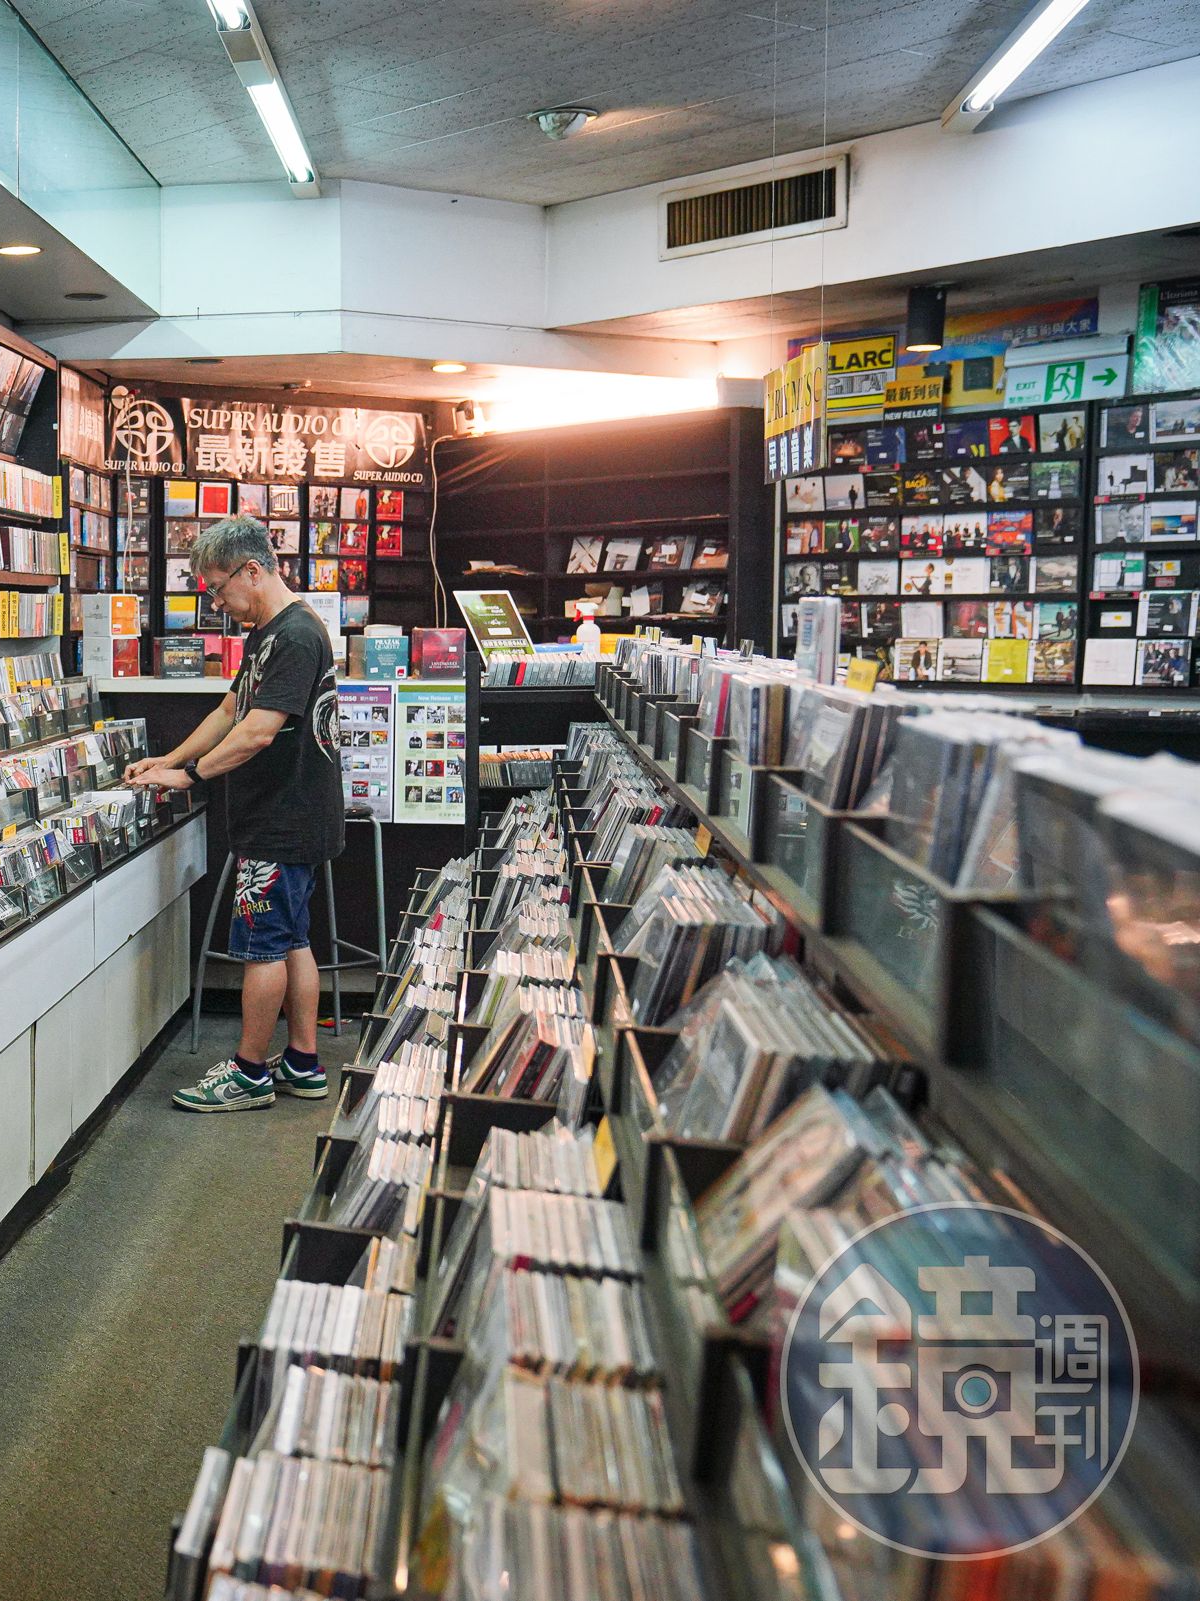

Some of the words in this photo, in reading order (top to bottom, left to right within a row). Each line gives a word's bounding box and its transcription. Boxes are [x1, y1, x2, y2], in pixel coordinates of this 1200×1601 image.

[828, 349, 892, 371] LARC
[885, 384, 941, 403] 最新到貨
[1016, 381, 1038, 391] EXIT
[189, 408, 256, 432] SUPER
[258, 412, 328, 436] AUDIO
[884, 411, 901, 421] NEW
[902, 408, 938, 419] RELEASE
[195, 434, 347, 478] 最新發售
[104, 459, 138, 471] SUPER
[137, 461, 170, 473] AUDIO
[172, 462, 186, 473] CD
[353, 469, 384, 481] SUPER
[382, 472, 411, 483] AUDIO
[411, 473, 424, 483] CD
